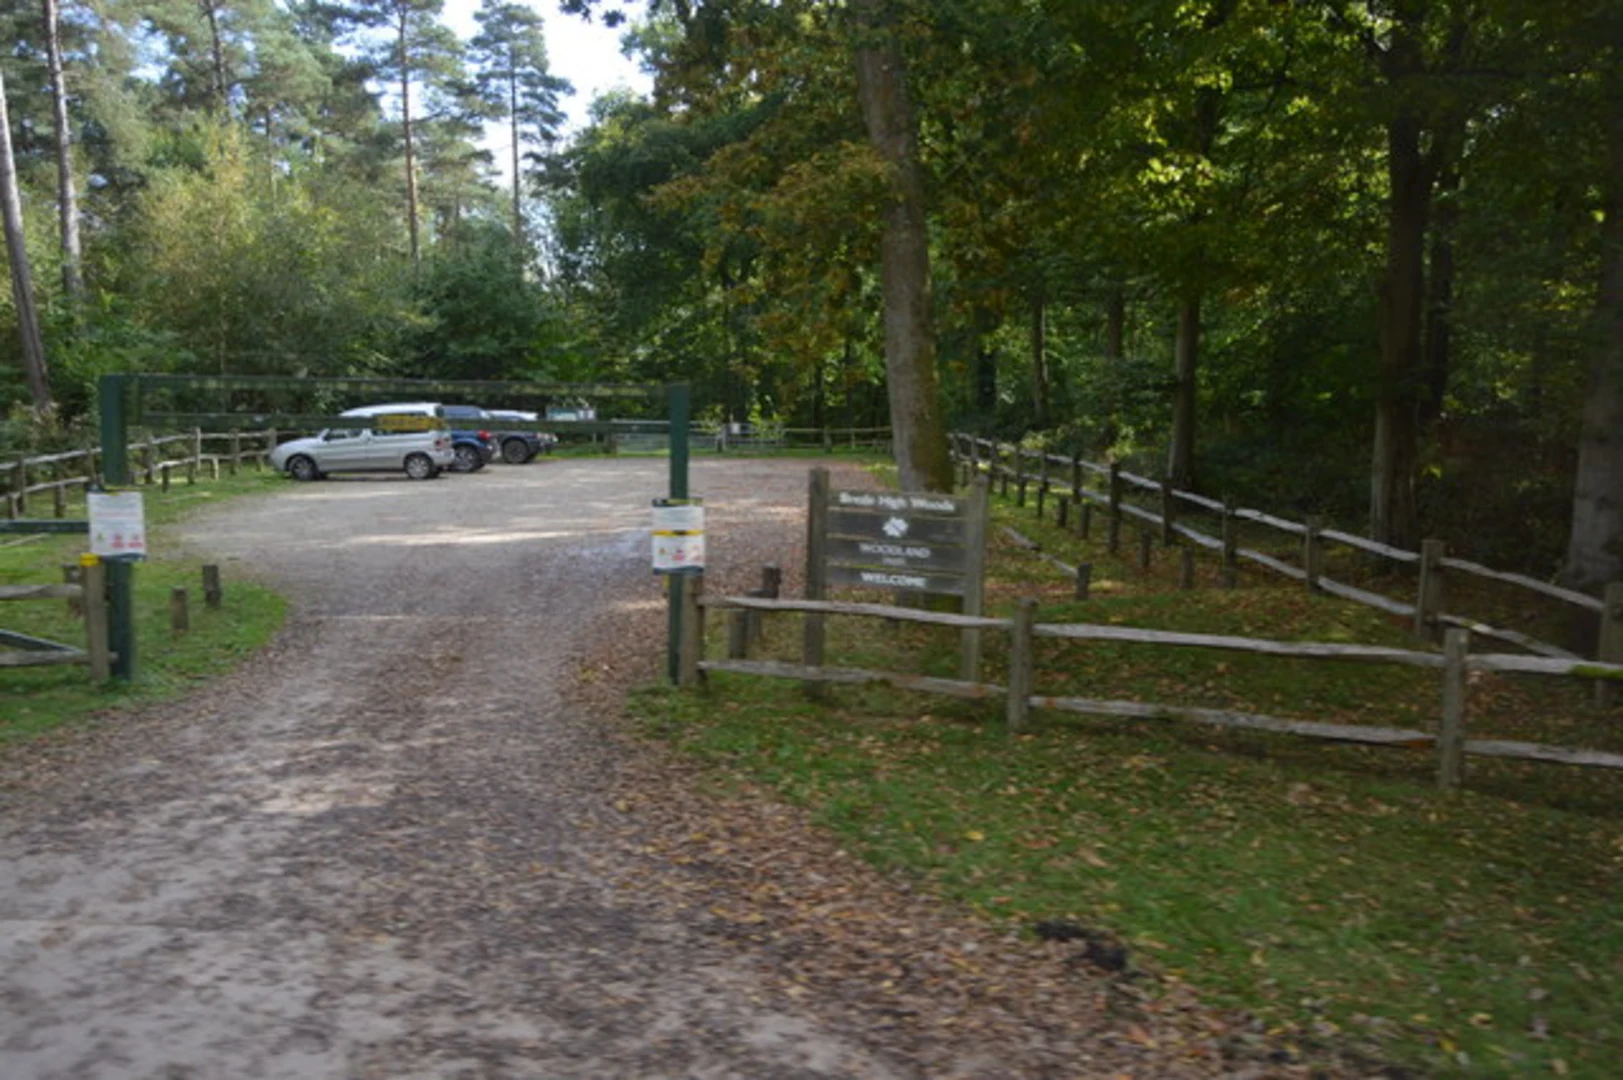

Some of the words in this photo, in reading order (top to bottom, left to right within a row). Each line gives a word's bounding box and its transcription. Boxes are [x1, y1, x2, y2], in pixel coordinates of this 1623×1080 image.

[878, 495, 907, 510] High
[909, 497, 955, 512] Woods
[859, 543, 931, 559] WOODLAND
[860, 572, 926, 588] WELCOME
